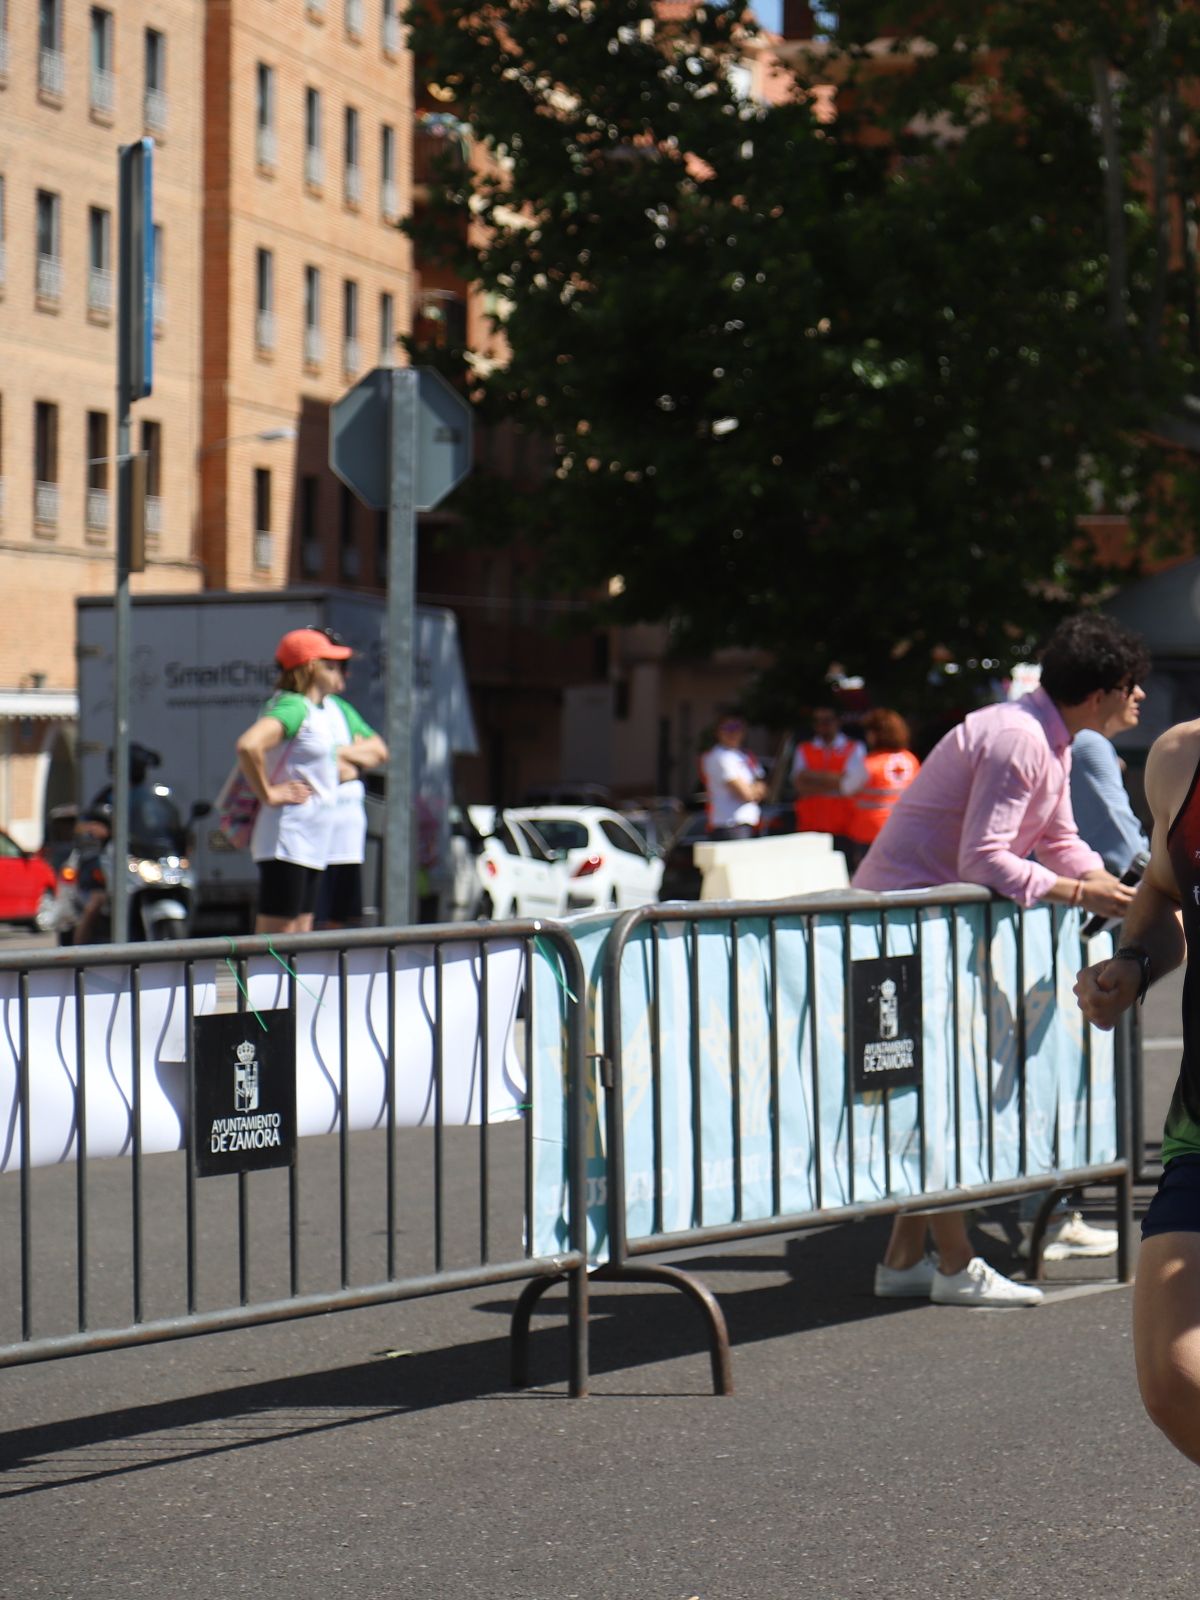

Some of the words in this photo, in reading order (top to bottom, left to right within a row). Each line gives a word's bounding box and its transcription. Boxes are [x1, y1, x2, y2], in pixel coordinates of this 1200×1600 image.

[211, 1113, 281, 1134] AYUNTAMIENTO
[211, 1133, 227, 1153] DE
[229, 1128, 281, 1152] ZAMORA
